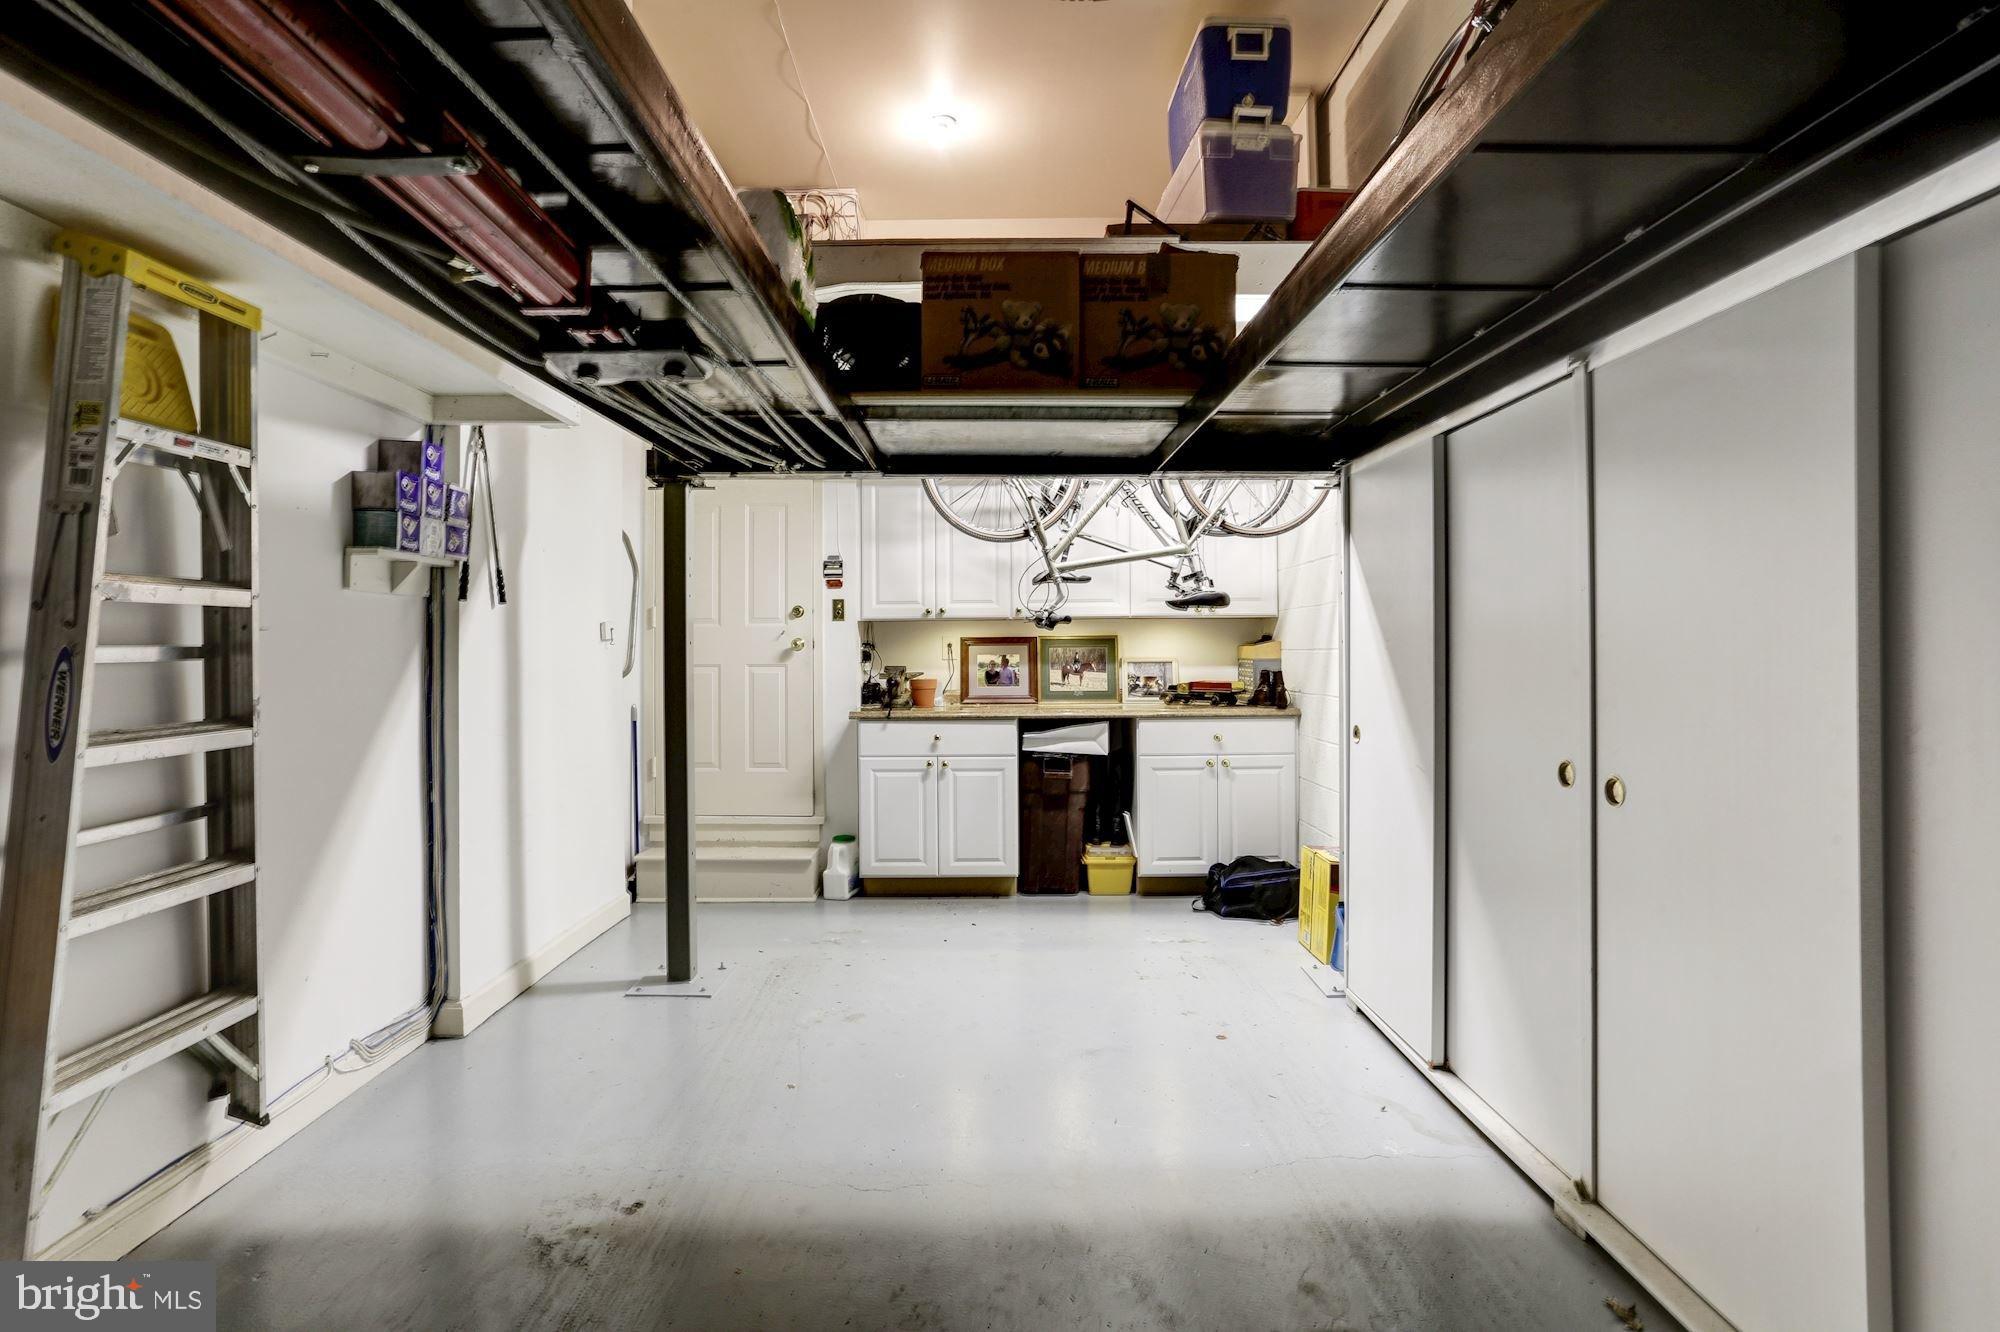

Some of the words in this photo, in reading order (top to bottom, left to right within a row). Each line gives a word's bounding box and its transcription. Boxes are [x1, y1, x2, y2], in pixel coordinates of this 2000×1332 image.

[924, 255, 977, 273] MEDIUM
[979, 254, 1006, 273] BOX
[1083, 260, 1134, 275] MEDIUM
[50, 671, 67, 741] WERNER
